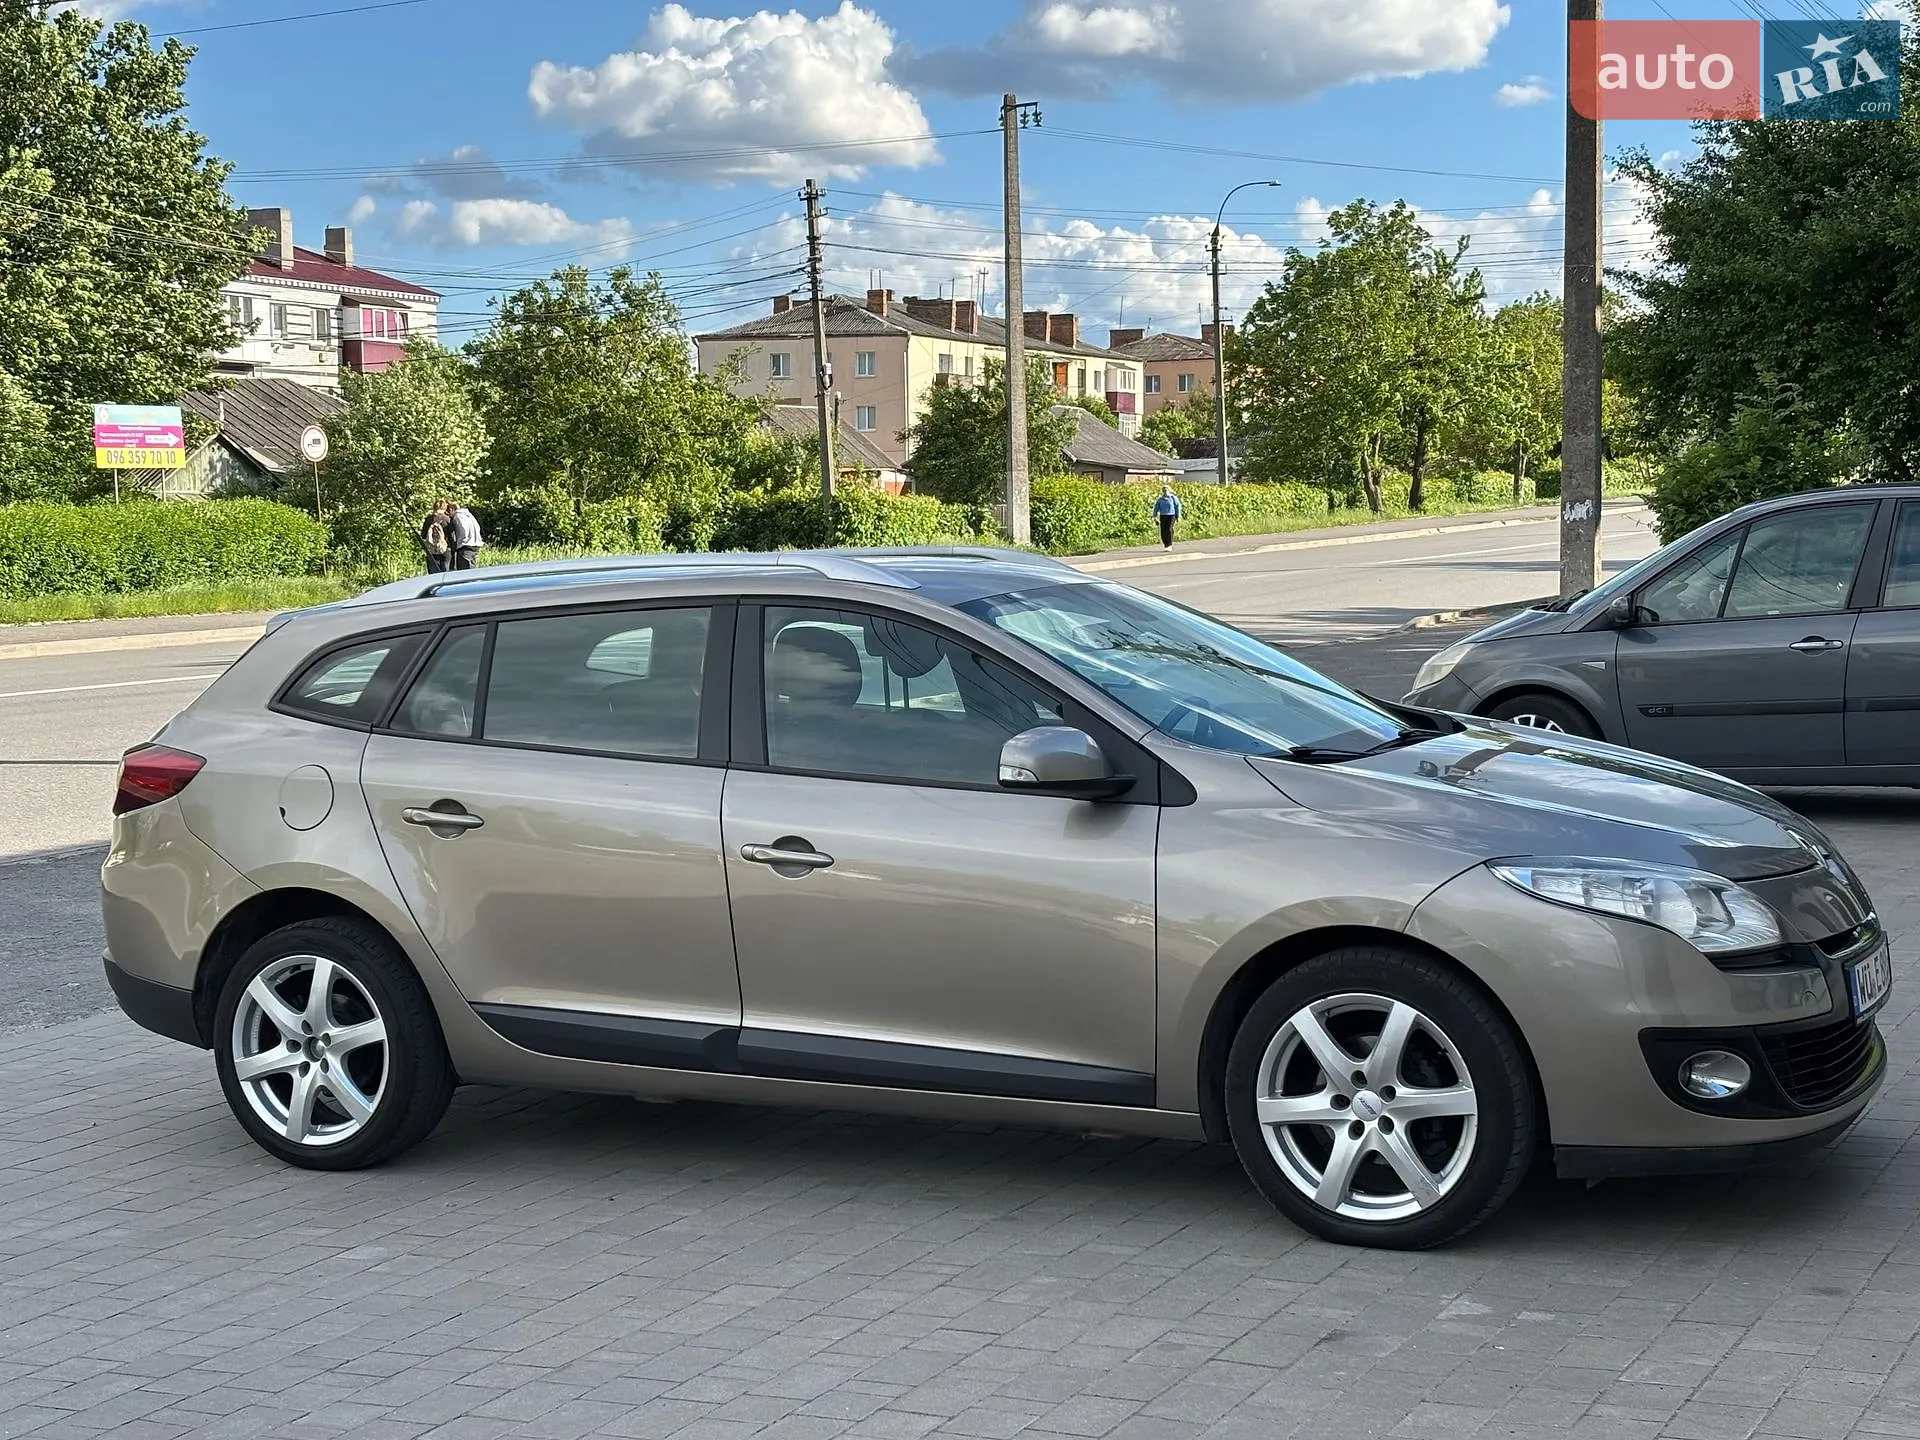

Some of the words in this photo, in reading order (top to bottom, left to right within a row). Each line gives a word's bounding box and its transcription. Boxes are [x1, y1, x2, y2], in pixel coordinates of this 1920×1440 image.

[106, 450, 125, 464] 096
[128, 450, 147, 464] 359
[151, 450, 162, 464] 70
[166, 450, 176, 464] 10
